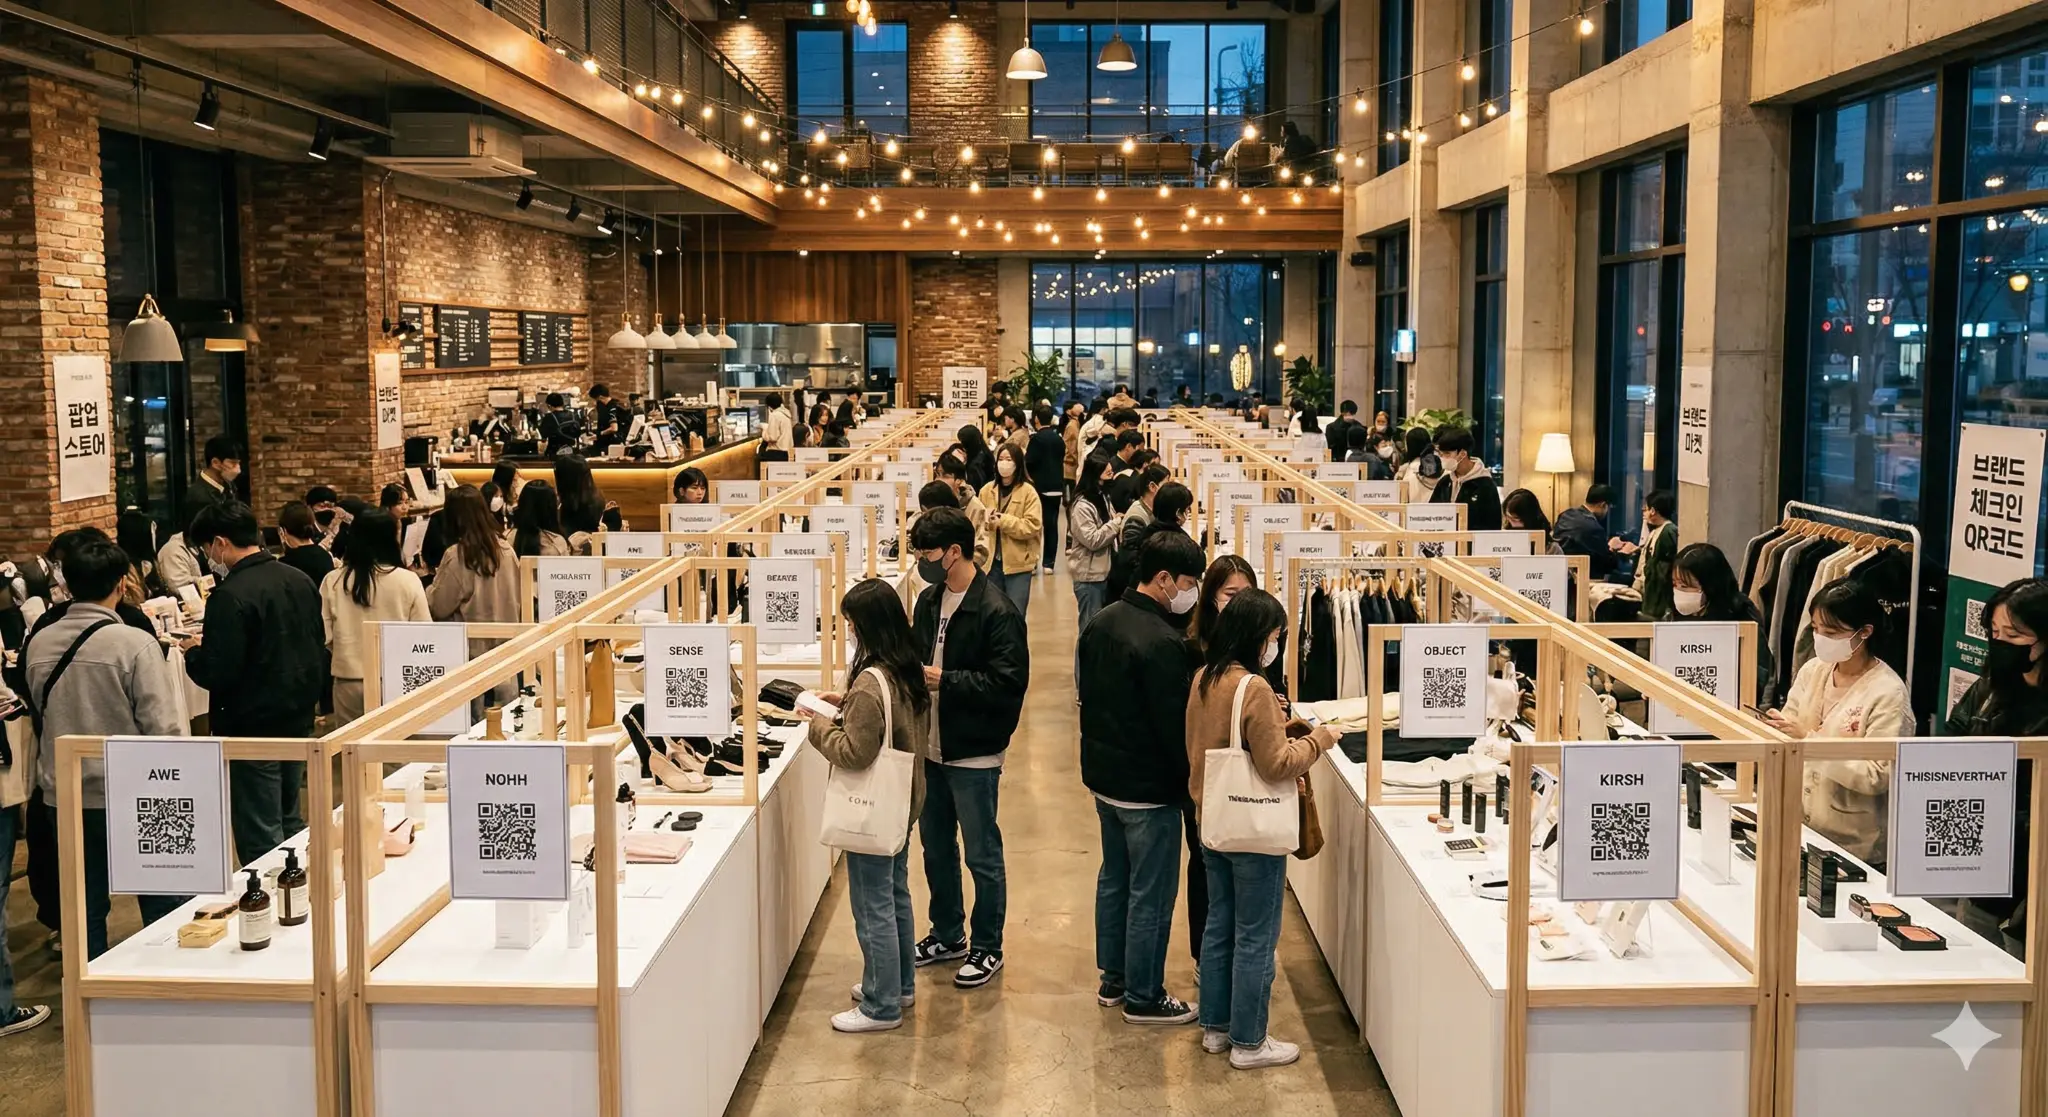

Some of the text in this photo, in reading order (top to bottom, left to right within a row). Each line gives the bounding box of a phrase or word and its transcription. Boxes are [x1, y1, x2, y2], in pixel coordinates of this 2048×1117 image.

[68, 401, 99, 429] 팝업
[1682, 407, 1707, 428] 브랜드
[64, 433, 105, 460] 스토어
[1685, 432, 1703, 455] 마켓
[1972, 454, 2026, 487] 브랜드
[1969, 487, 2023, 523] 체크인
[1964, 523, 2024, 559] QR코드
[411, 644, 435, 654] AWE
[669, 646, 704, 656] SENSE
[1423, 646, 1467, 656] OBJECT
[1680, 644, 1712, 654] KIRSH
[148, 769, 181, 781] AWE
[486, 773, 528, 786] NOHH
[1600, 773, 1644, 786] KIRSH
[1905, 771, 2008, 782] THISISNEVERTHAT
